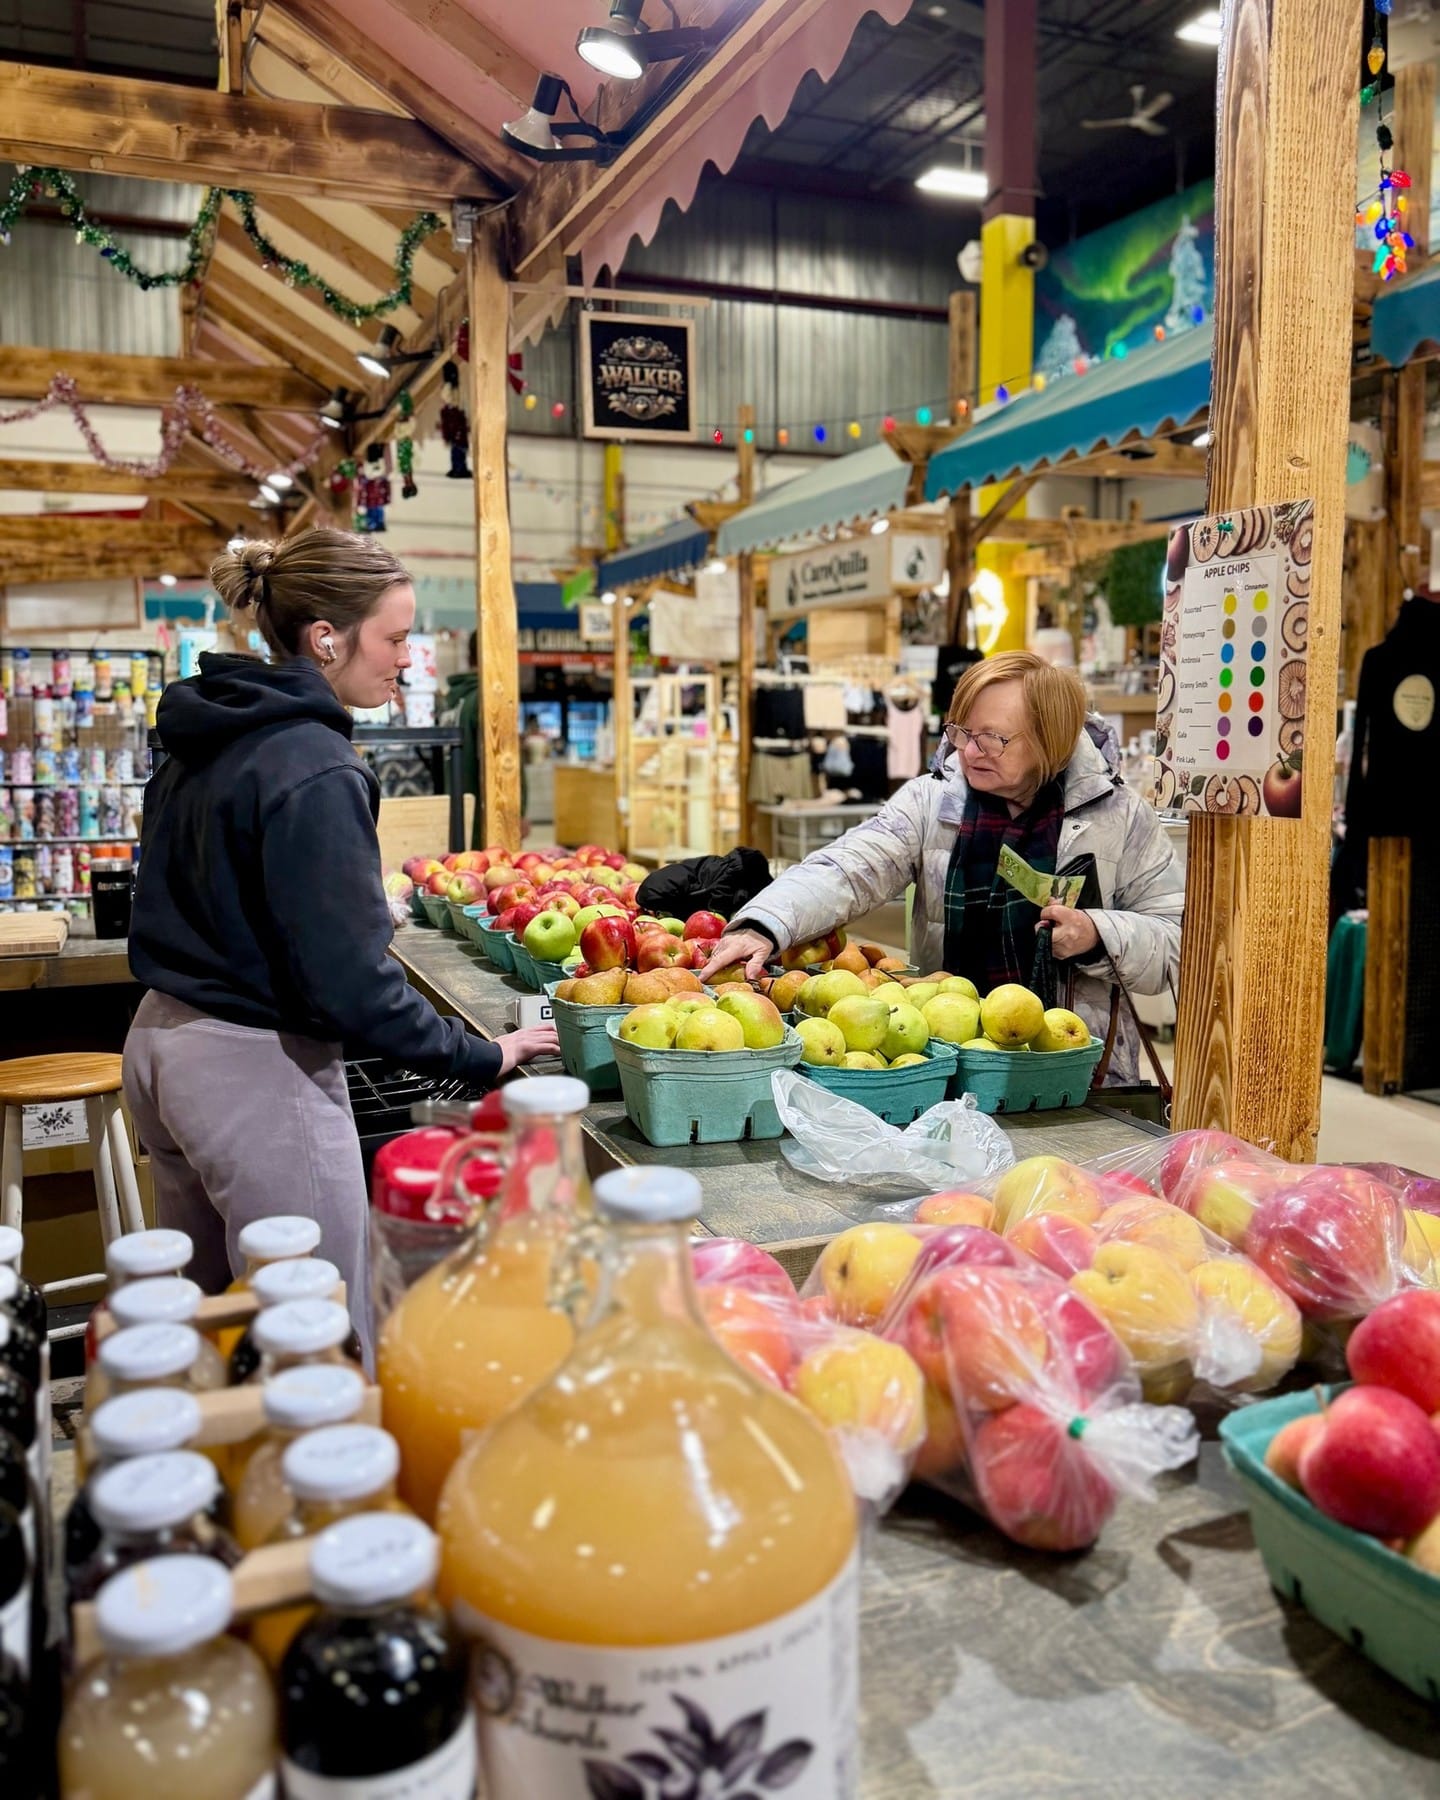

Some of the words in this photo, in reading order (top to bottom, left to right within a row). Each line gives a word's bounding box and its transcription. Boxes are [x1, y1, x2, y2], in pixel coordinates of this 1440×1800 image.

[599, 364, 684, 395] WALKER
[1204, 566, 1225, 579] APPLE
[1227, 562, 1250, 575] CHIPS
[1244, 583, 1268, 591] Cinnamon
[1184, 606, 1202, 614] Assorted
[1183, 631, 1205, 640] Honeycrisp
[1180, 682, 1194, 690] Granny
[1179, 706, 1192, 714] Aurora
[1177, 731, 1187, 739] Gala
[1185, 756, 1196, 764] Lady
[638, 1662, 706, 1685] 100%
[715, 1641, 772, 1674] APPLE
[526, 1672, 645, 1718] Walker
